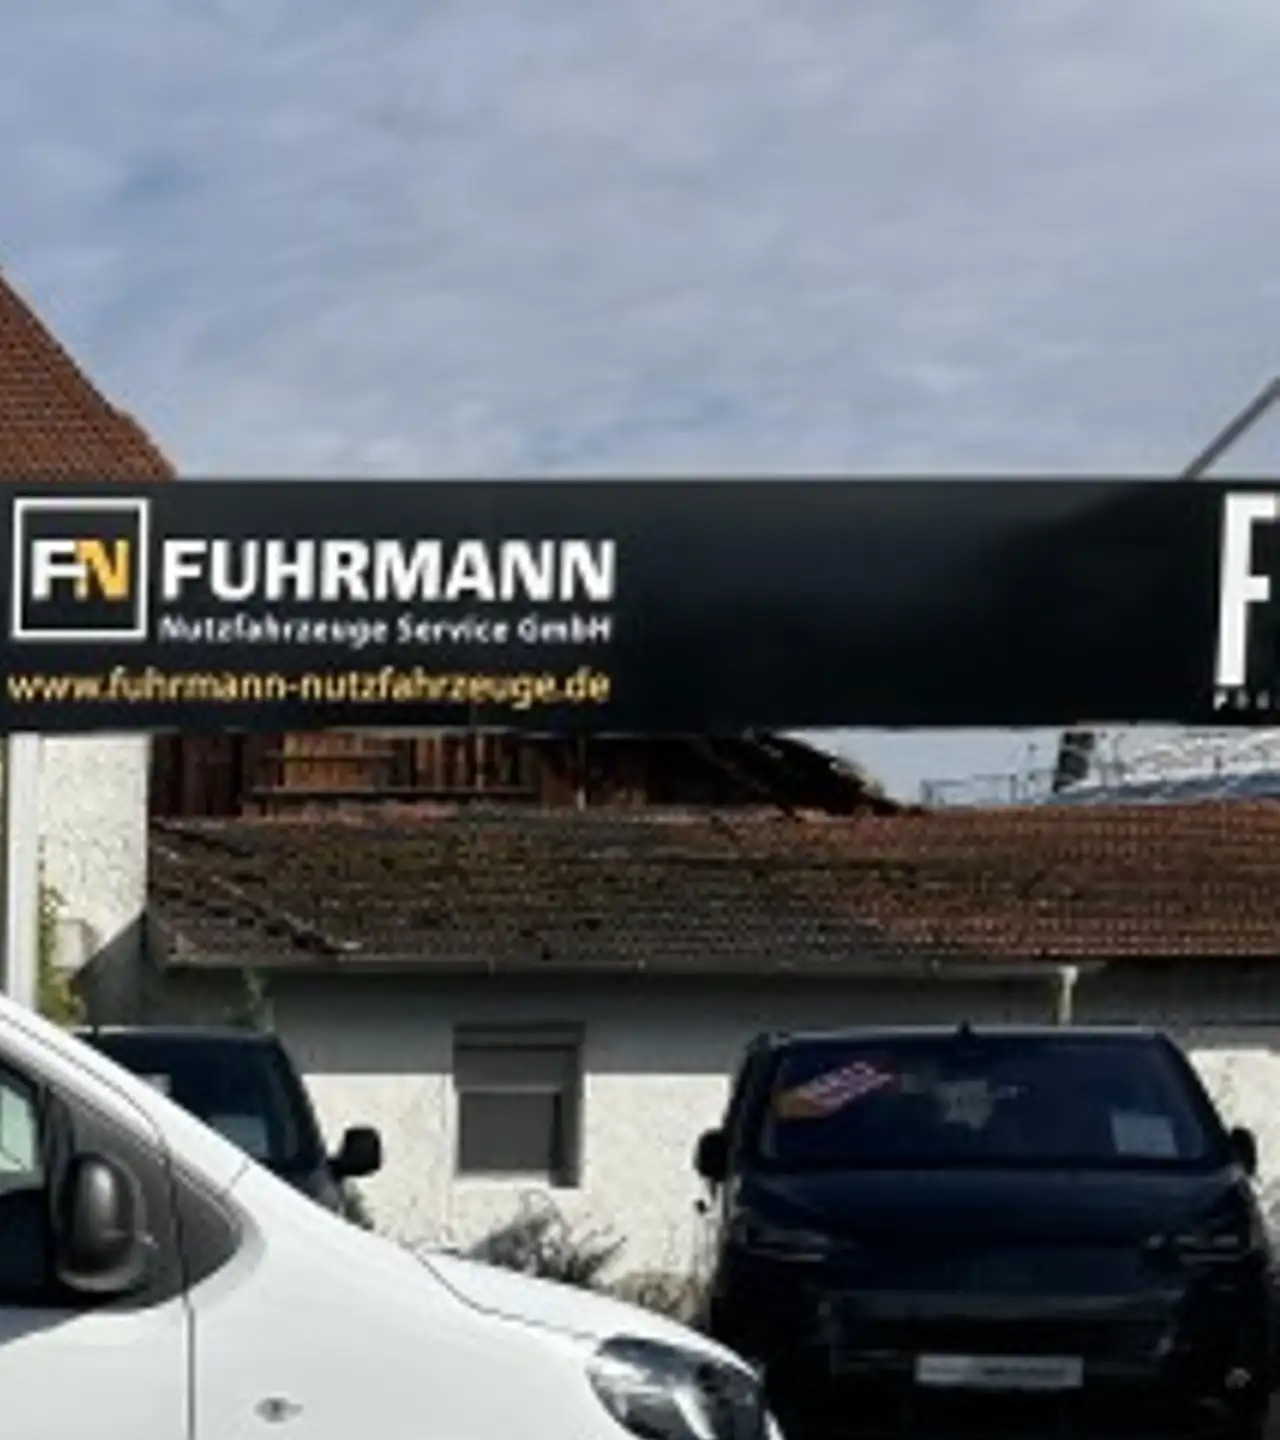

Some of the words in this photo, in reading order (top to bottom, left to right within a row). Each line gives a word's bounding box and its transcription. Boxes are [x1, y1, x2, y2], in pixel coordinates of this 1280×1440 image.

[31, 539, 130, 599] FN
[162, 539, 617, 601] FUHRMANN
[159, 613, 388, 649] Nutzfahrzeuge
[397, 614, 508, 644] Service
[518, 613, 612, 643] GmbH
[7, 665, 610, 710] www.fuhrmann-nutzfahrzeuge.de
